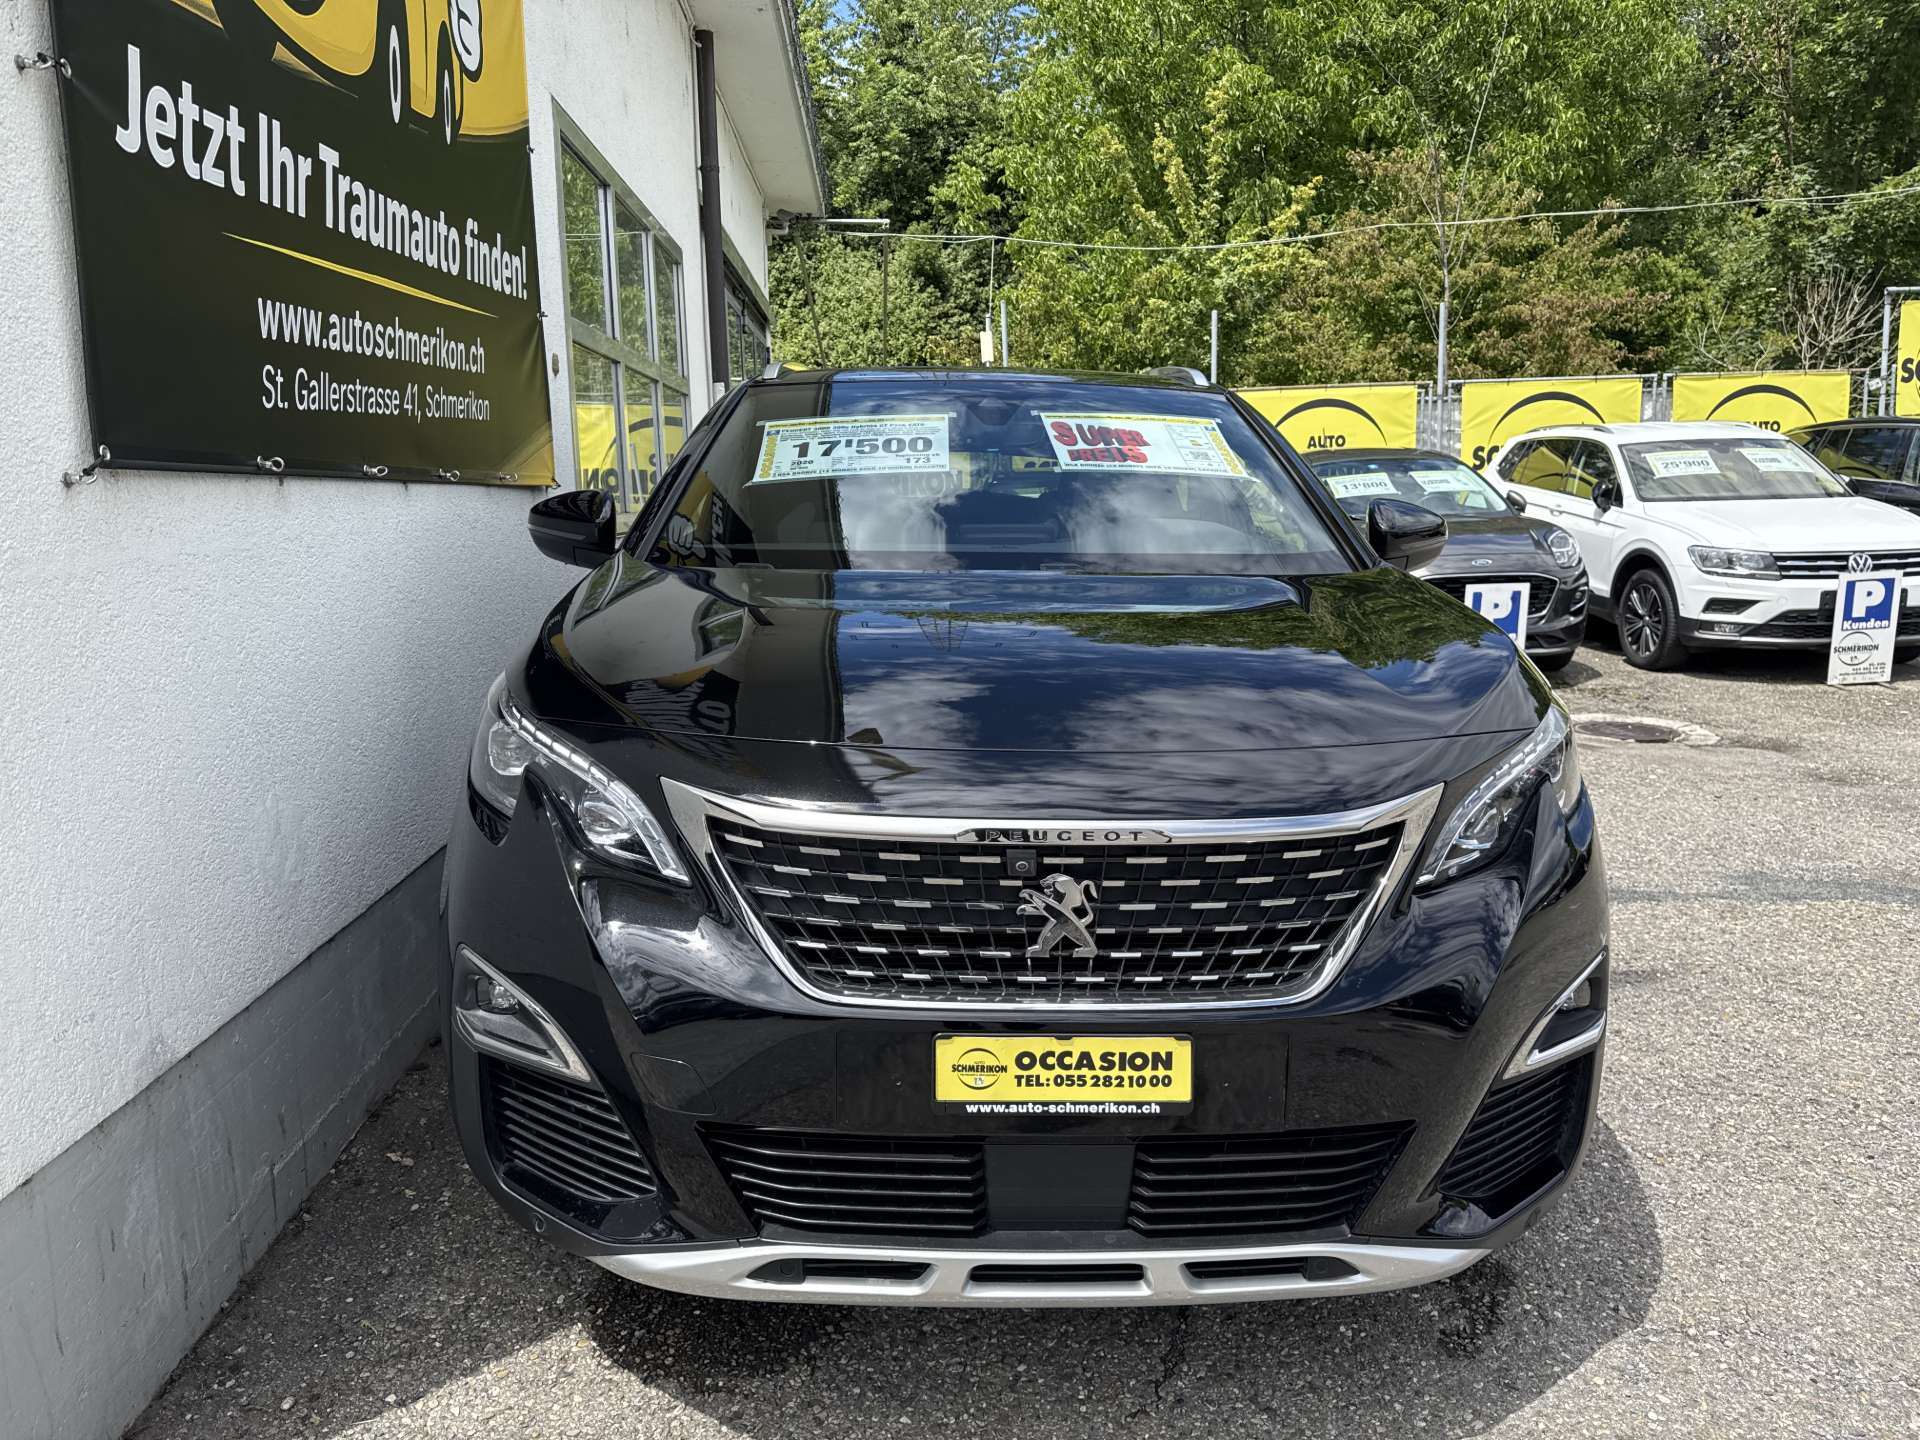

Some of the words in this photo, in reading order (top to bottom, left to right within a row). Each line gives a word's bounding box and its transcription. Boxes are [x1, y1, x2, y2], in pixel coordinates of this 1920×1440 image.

[115, 44, 246, 198] Jetzt
[258, 112, 312, 219] Ihr
[319, 144, 460, 276] Traumauto
[465, 218, 528, 300] finden!
[257, 298, 486, 374] www.autoschmerikon.ch
[261, 365, 289, 411] St.
[295, 367, 400, 417] Gallerstrasse
[425, 391, 490, 422] Schmerikon
[792, 437, 933, 459] 17'500
[1308, 434, 1346, 449] AUTO
[1851, 580, 1886, 618] P
[1842, 619, 1889, 630] Kunden
[985, 830, 1147, 842] PEUGEOT
[951, 1064, 1008, 1074] SCHMERIKON
[1014, 1051, 1173, 1072] OCCASION
[966, 1102, 1161, 1114] www.auto-schmerikon.ch
